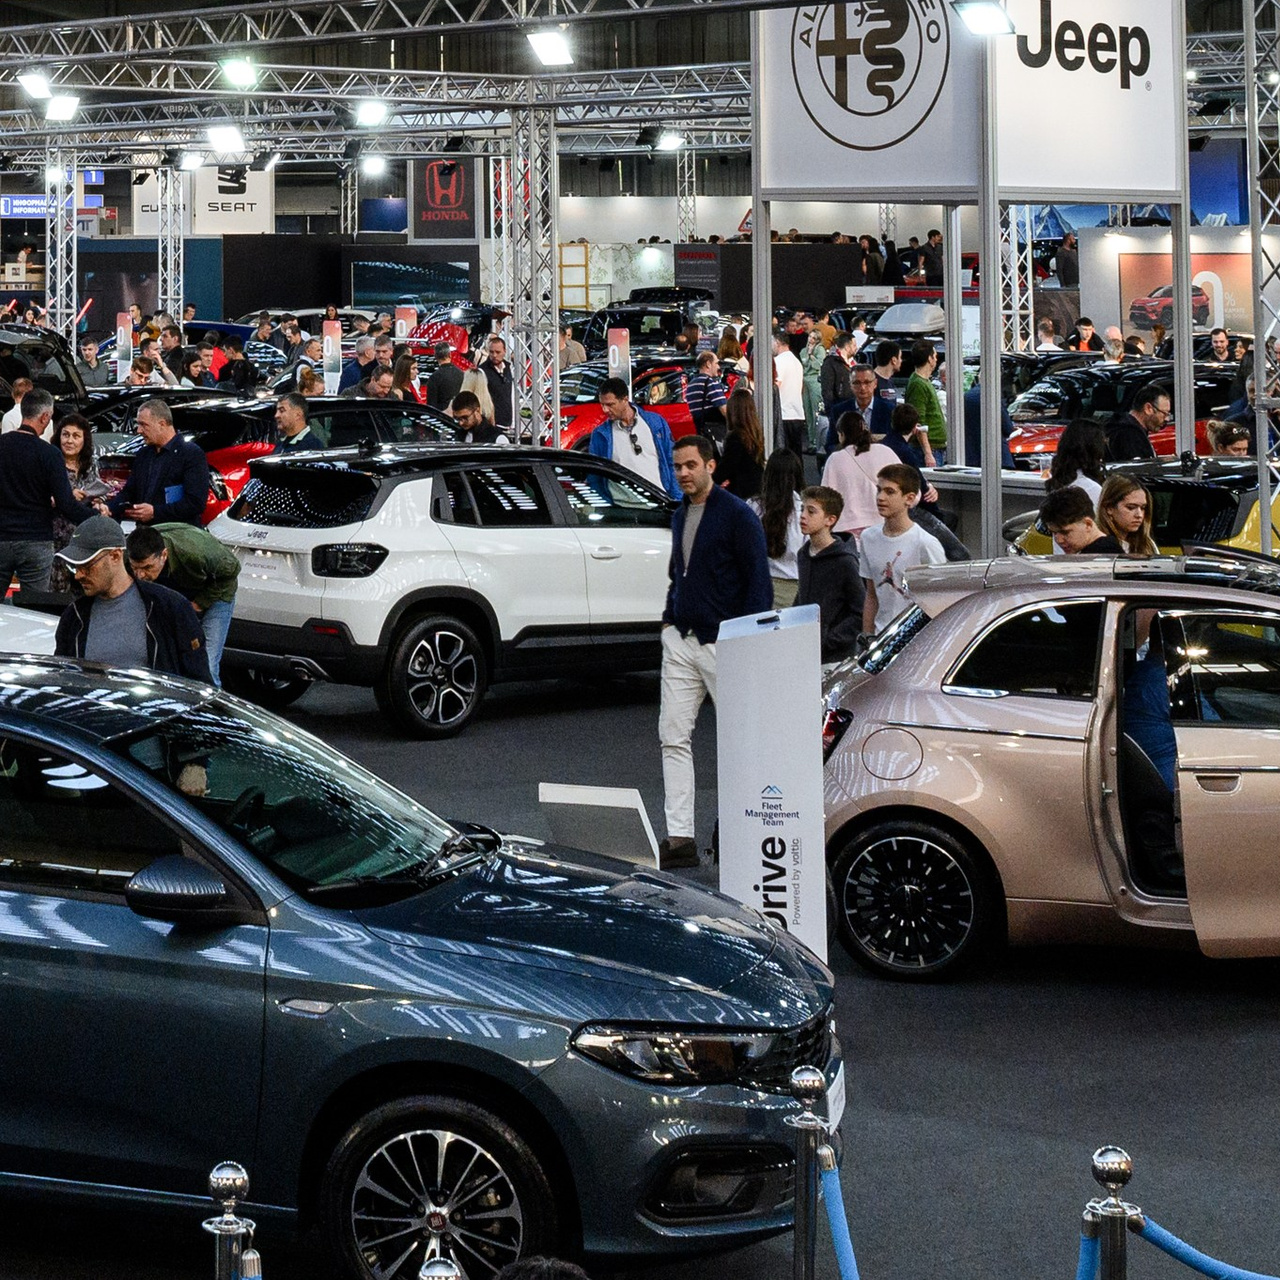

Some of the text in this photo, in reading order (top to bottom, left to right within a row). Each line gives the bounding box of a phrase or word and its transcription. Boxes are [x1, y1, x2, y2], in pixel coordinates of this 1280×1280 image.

[1016, 0, 1151, 89] Jeep
[207, 202, 257, 212] SEAT
[421, 211, 469, 221] HONDA
[247, 528, 269, 540] Jeep
[761, 802, 782, 811] Fleet
[745, 809, 800, 819] Management
[762, 818, 784, 826] Team
[791, 838, 802, 926] Powered by voltic
